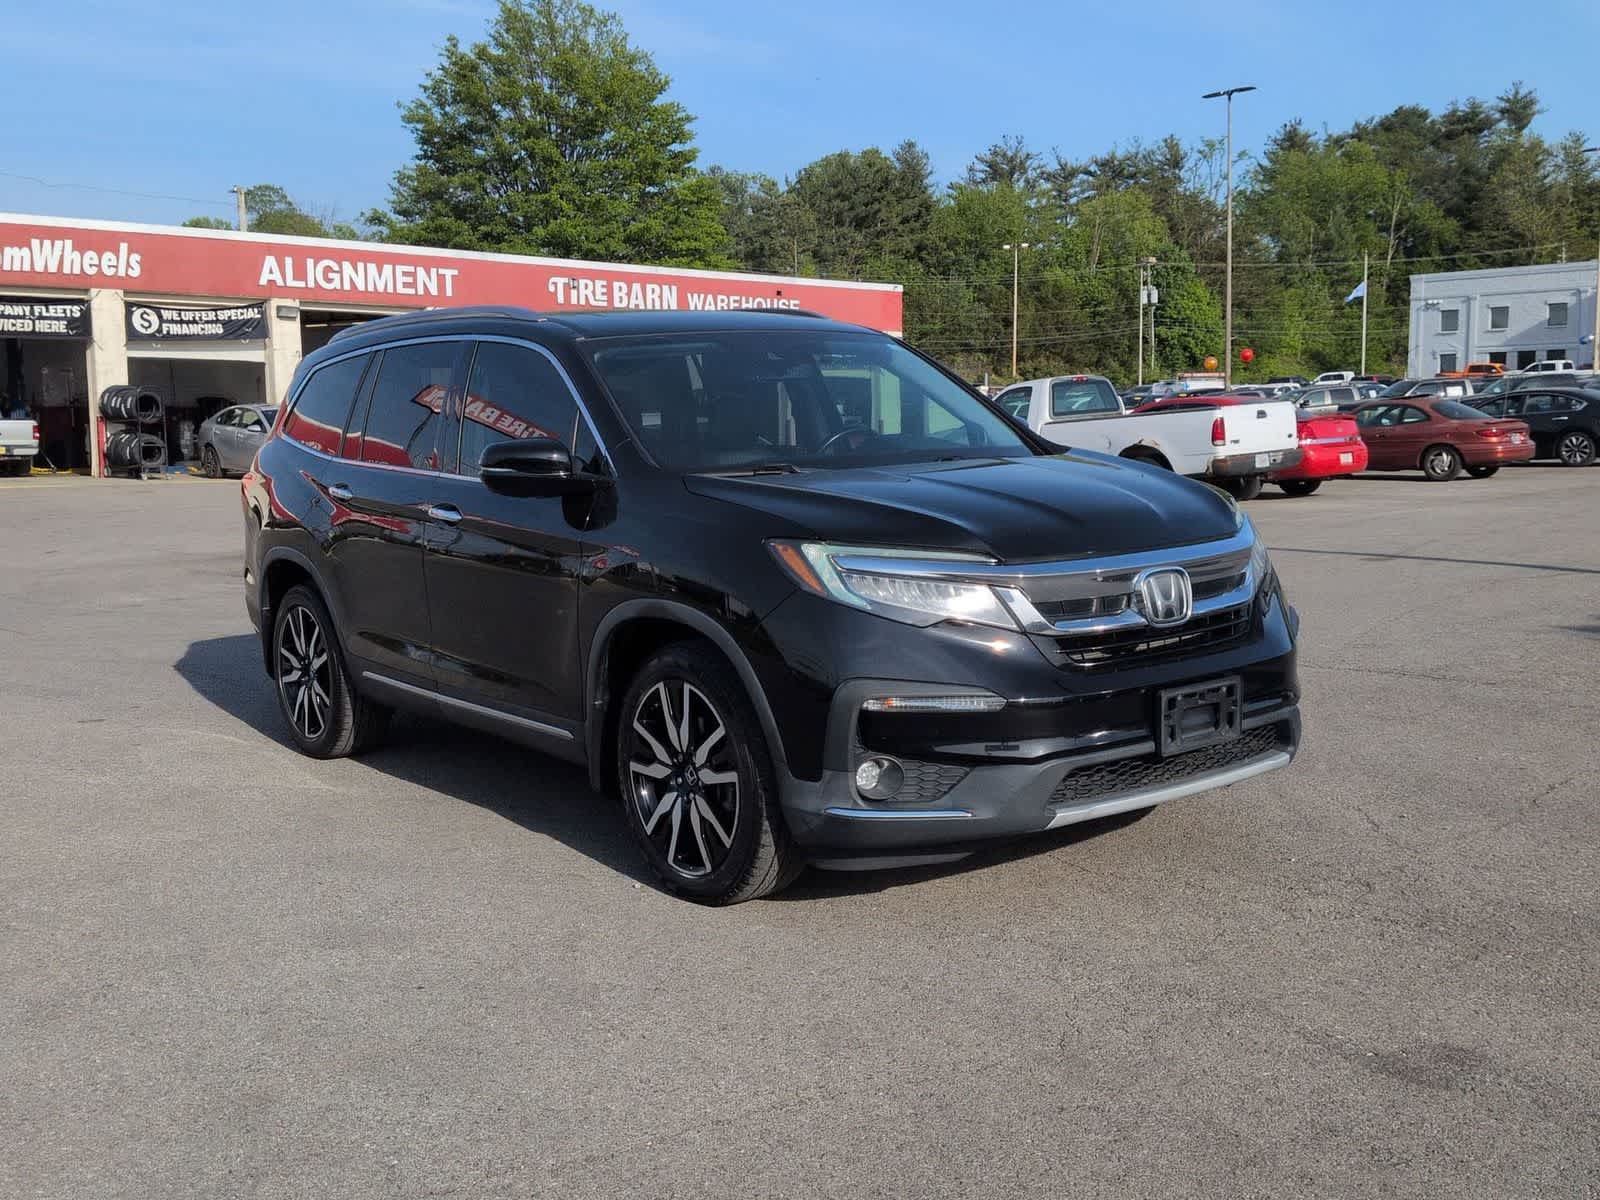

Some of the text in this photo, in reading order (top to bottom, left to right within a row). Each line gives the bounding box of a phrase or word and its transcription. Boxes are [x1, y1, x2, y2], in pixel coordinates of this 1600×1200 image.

[0, 238, 142, 278] mWheels
[259, 255, 460, 298] ALIGNMENT
[612, 281, 678, 310] BARN
[33, 305, 81, 317] FLEETS
[161, 309, 180, 320] WE
[217, 307, 262, 321] SPECIAL
[35, 320, 68, 333] HERE
[162, 323, 224, 335] FINANCING
